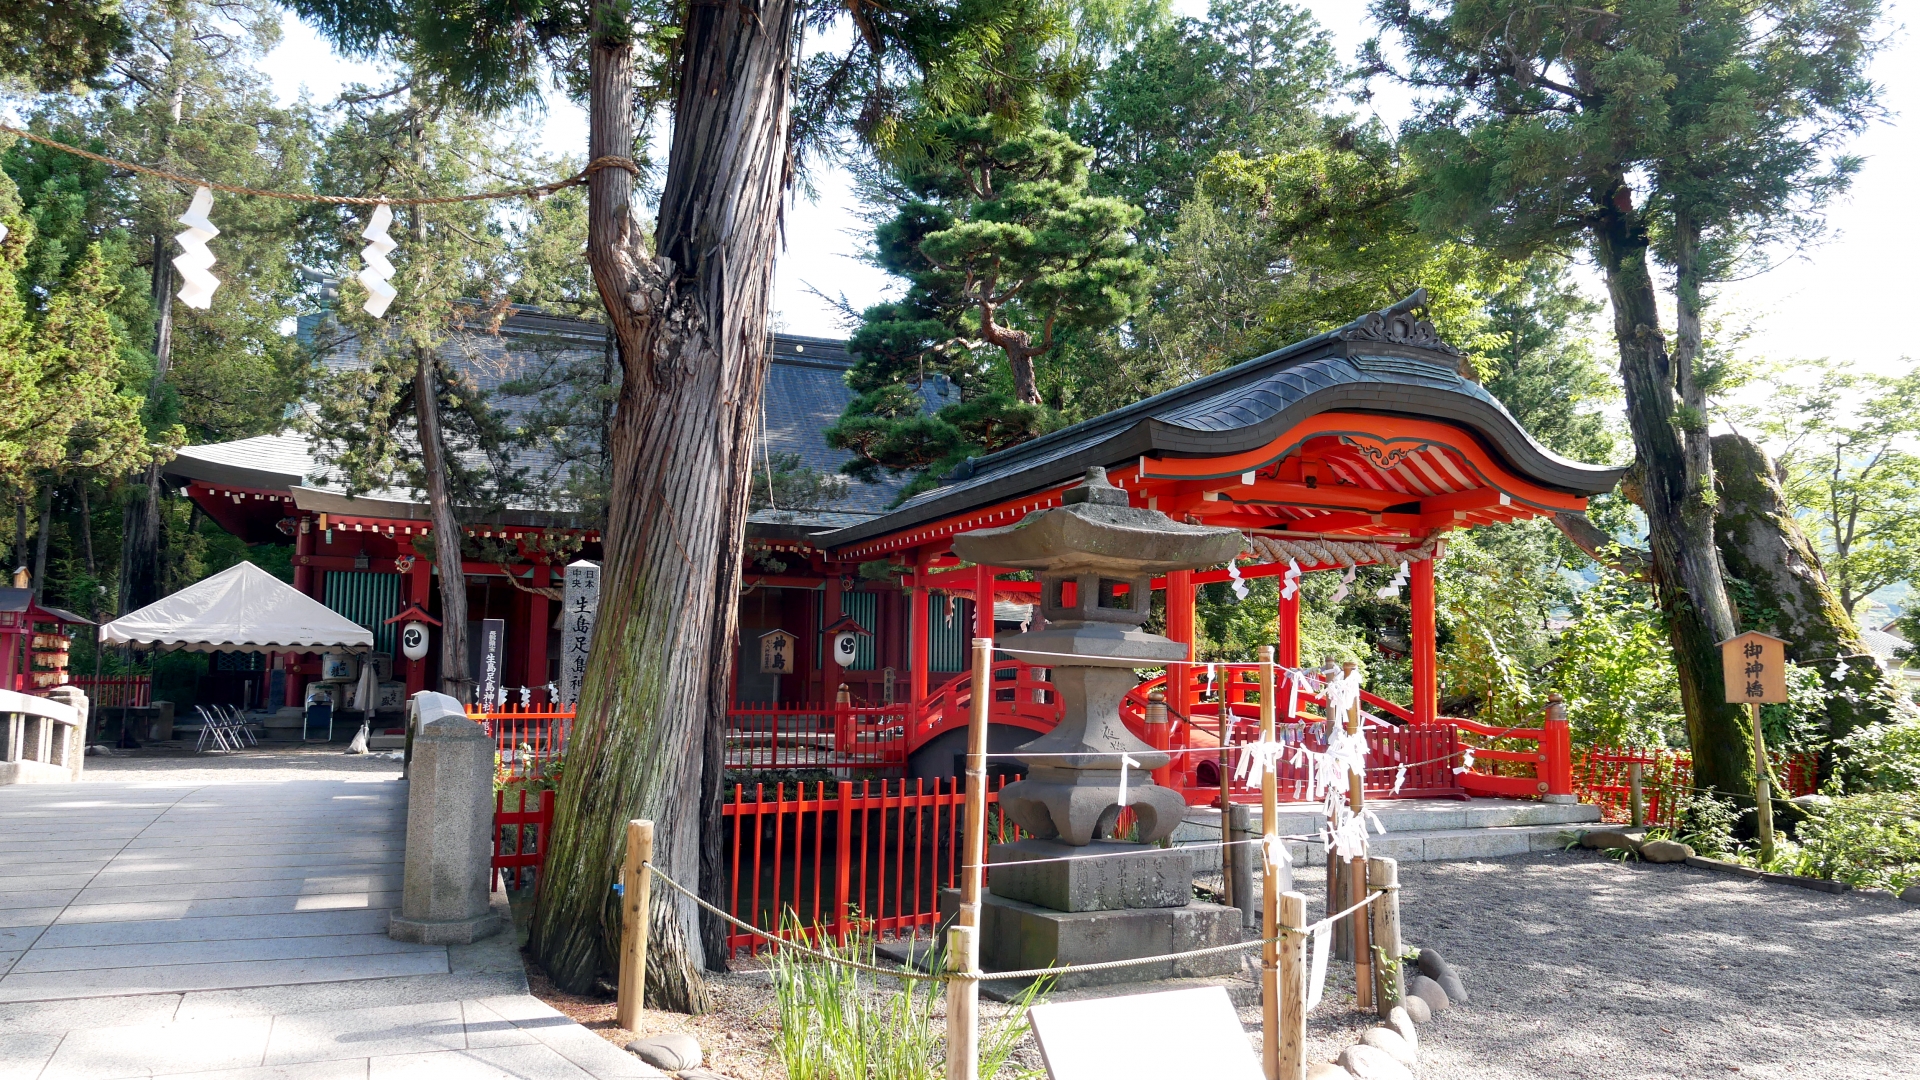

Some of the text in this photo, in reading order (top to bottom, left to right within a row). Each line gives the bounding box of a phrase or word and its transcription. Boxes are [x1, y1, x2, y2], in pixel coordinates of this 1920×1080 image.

[572, 569, 582, 588] 中央
[585, 570, 595, 589] 日本
[772, 635, 787, 670] 神島
[1743, 640, 1764, 698] 御神橋
